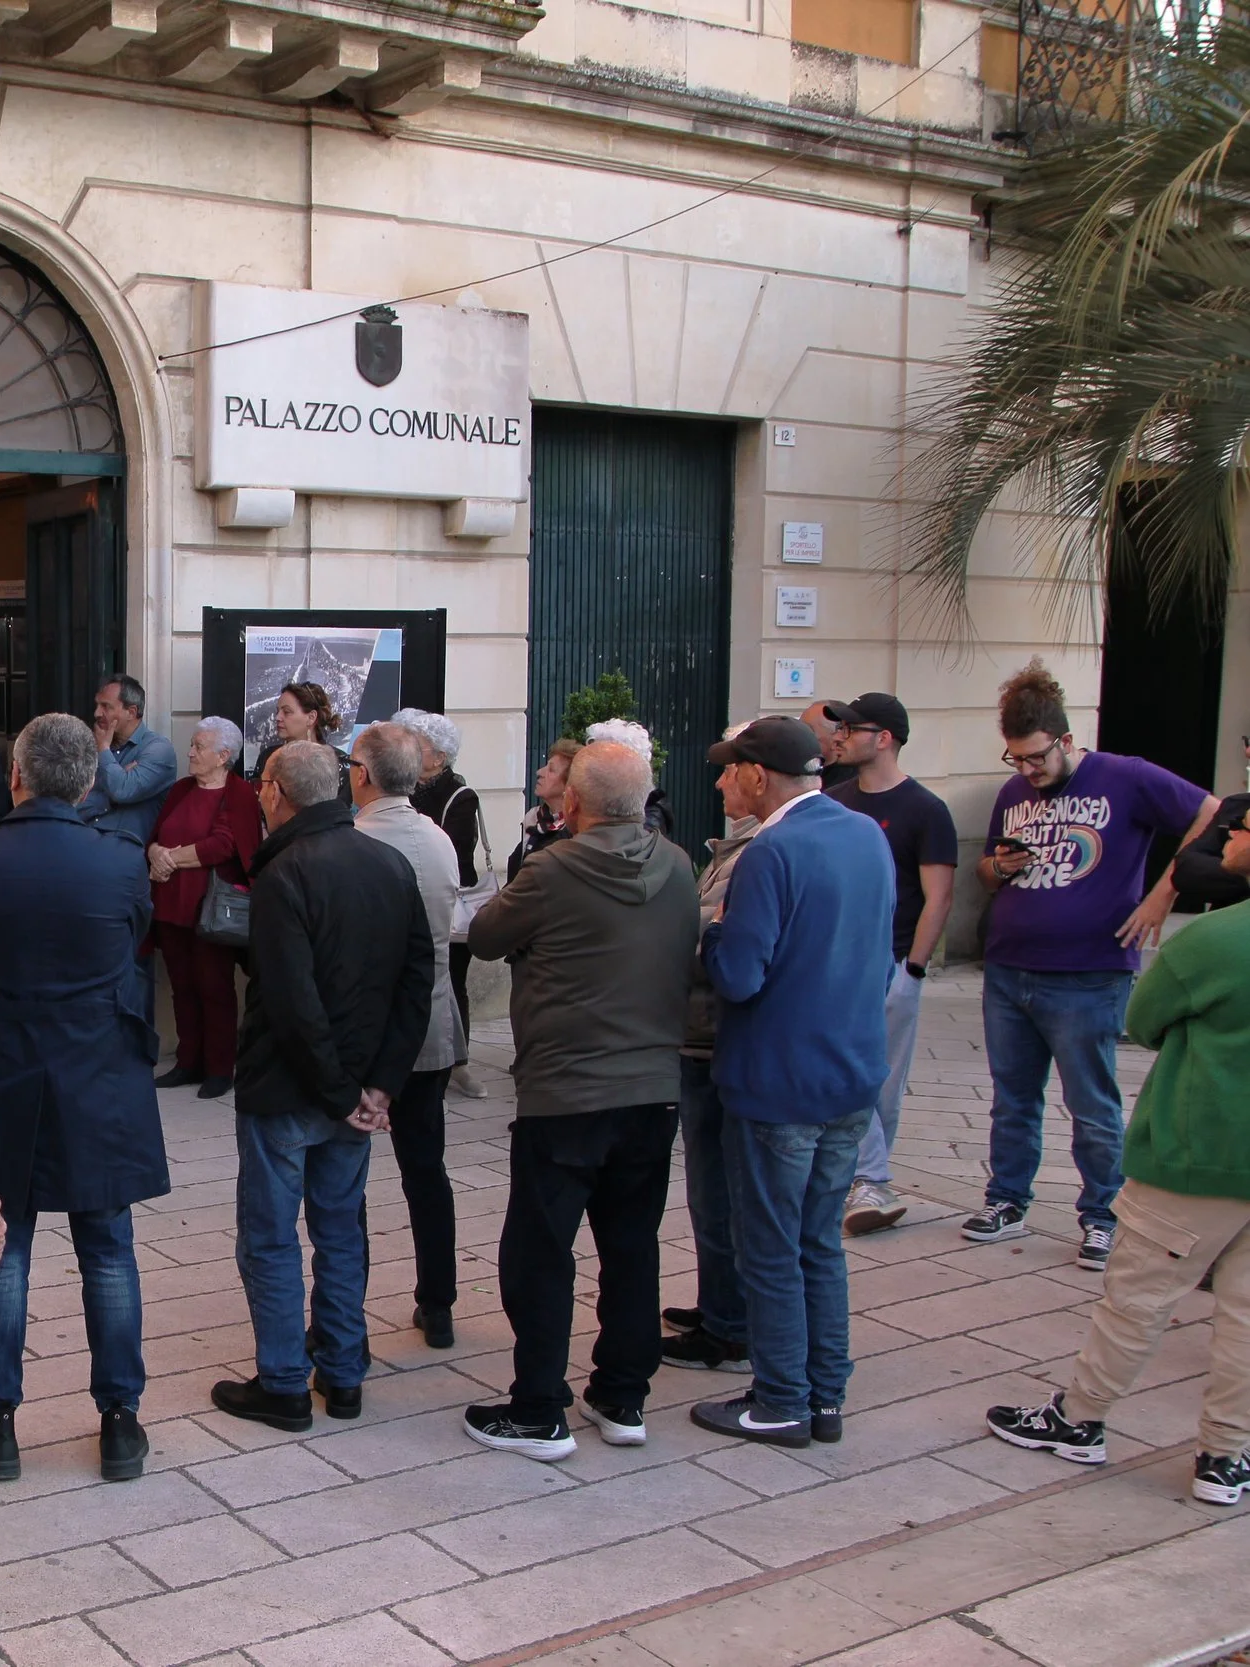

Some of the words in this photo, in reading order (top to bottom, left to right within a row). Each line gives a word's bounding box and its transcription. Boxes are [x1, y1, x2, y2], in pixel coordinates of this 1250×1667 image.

[224, 395, 362, 433] PALAZZO
[368, 407, 522, 446] COMUNALE
[781, 430, 790, 441] 12
[1002, 795, 1111, 837] UNDIAGNOSED
[1021, 823, 1053, 845] BUT
[1027, 841, 1077, 865] RETTY
[820, 1407, 837, 1415] NIKE
